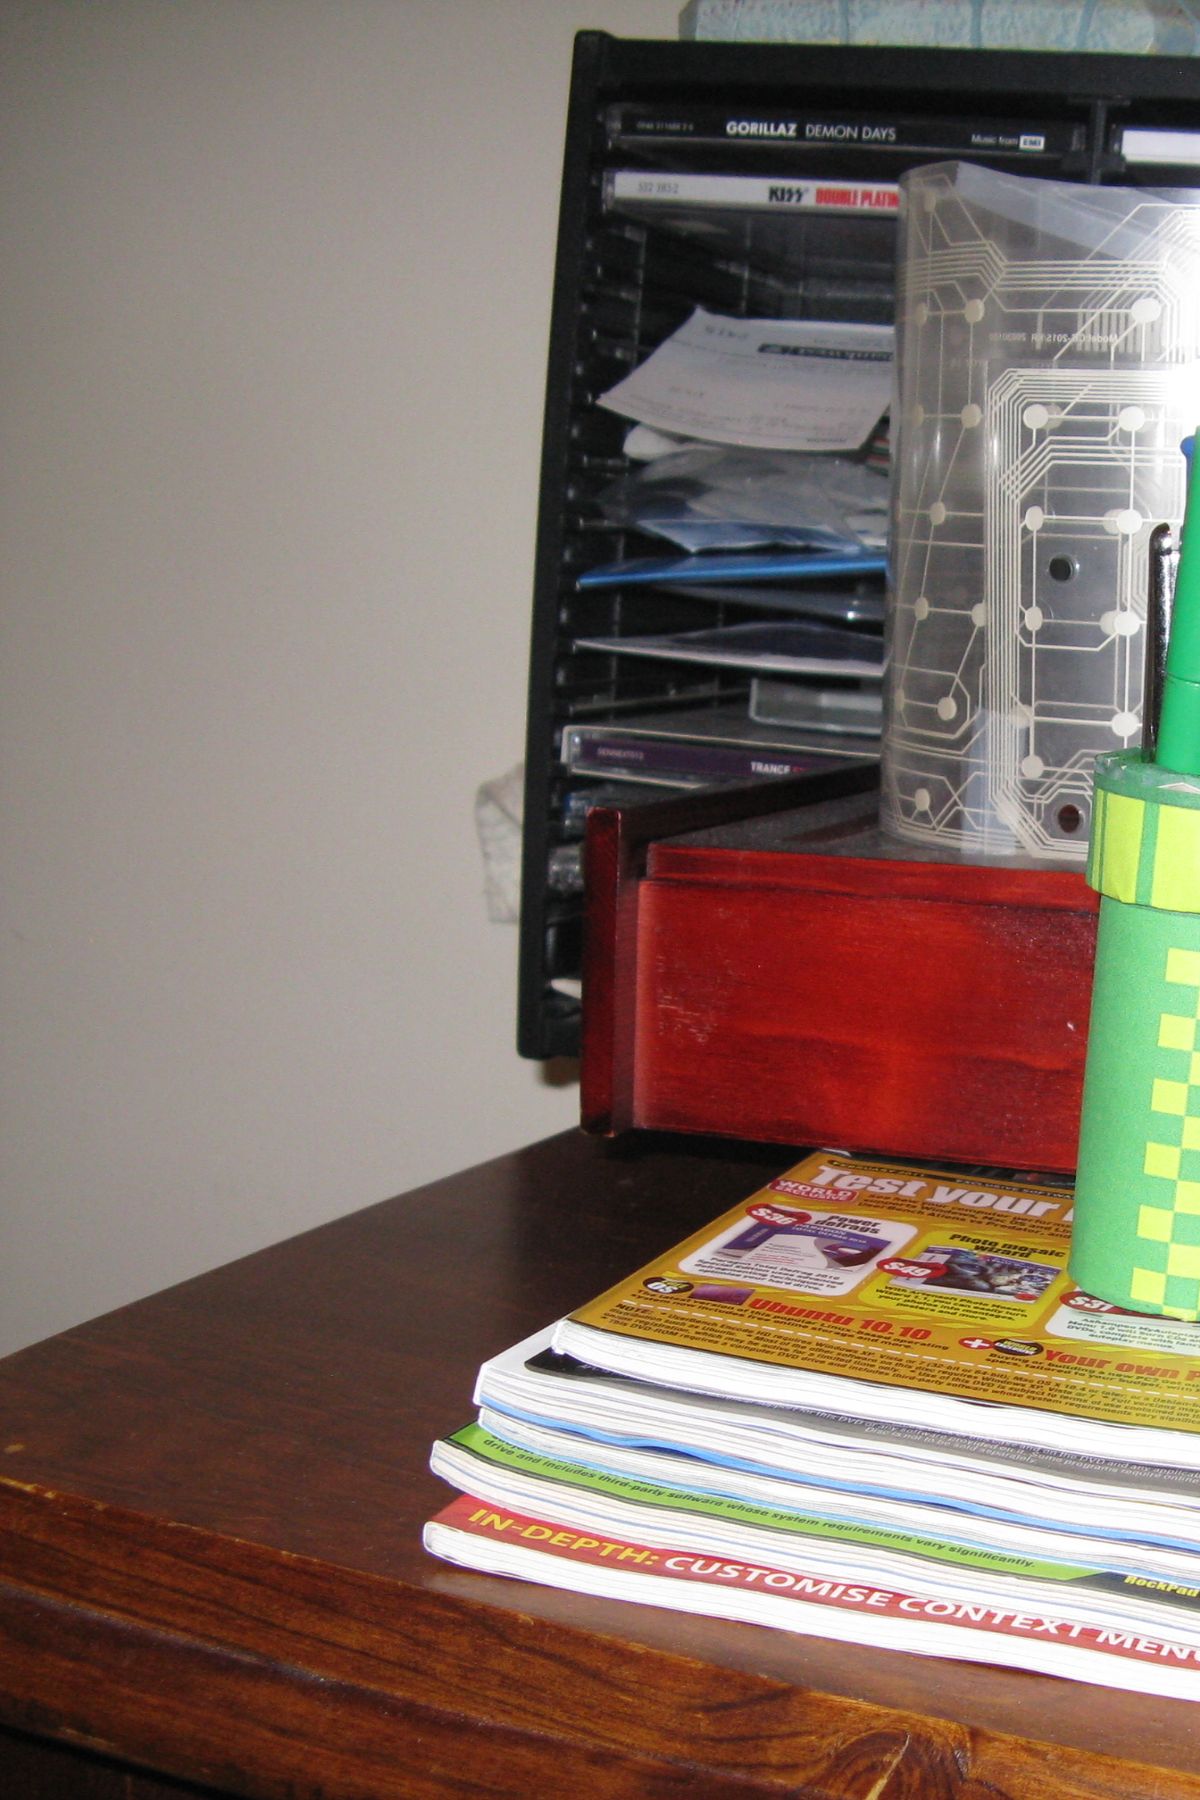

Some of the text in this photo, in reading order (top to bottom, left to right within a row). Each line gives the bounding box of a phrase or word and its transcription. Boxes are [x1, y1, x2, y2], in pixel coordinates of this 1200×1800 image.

[726, 121, 896, 141] GORILLAZ DEMON DAYS
[769, 186, 899, 208] KISS DOUBLE PLATIN
[771, 1179, 854, 1201] WORLD EXCLUSIVE
[806, 1165, 1058, 1218] Test your
[748, 1206, 800, 1225] $36
[814, 1219, 881, 1234] defrags
[828, 1215, 881, 1227] Power
[949, 1233, 1066, 1257] Photo mosaic
[973, 1244, 1031, 1258] wizard
[882, 1260, 932, 1277] $49
[646, 1280, 679, 1294] OS
[748, 1297, 932, 1341] Ubuntu 10.10
[1041, 1349, 1111, 1370] Your
[1115, 1360, 1179, 1380] own
[483, 1437, 1036, 1568] drive and includes third-party software whose system requirements vary significantly.
[468, 1508, 659, 1566] IN-DEPTH:
[664, 1554, 894, 1609] CUSTOMISE
[897, 1598, 1094, 1639] CONTEXT
[1123, 1574, 1200, 1598] RockPad
